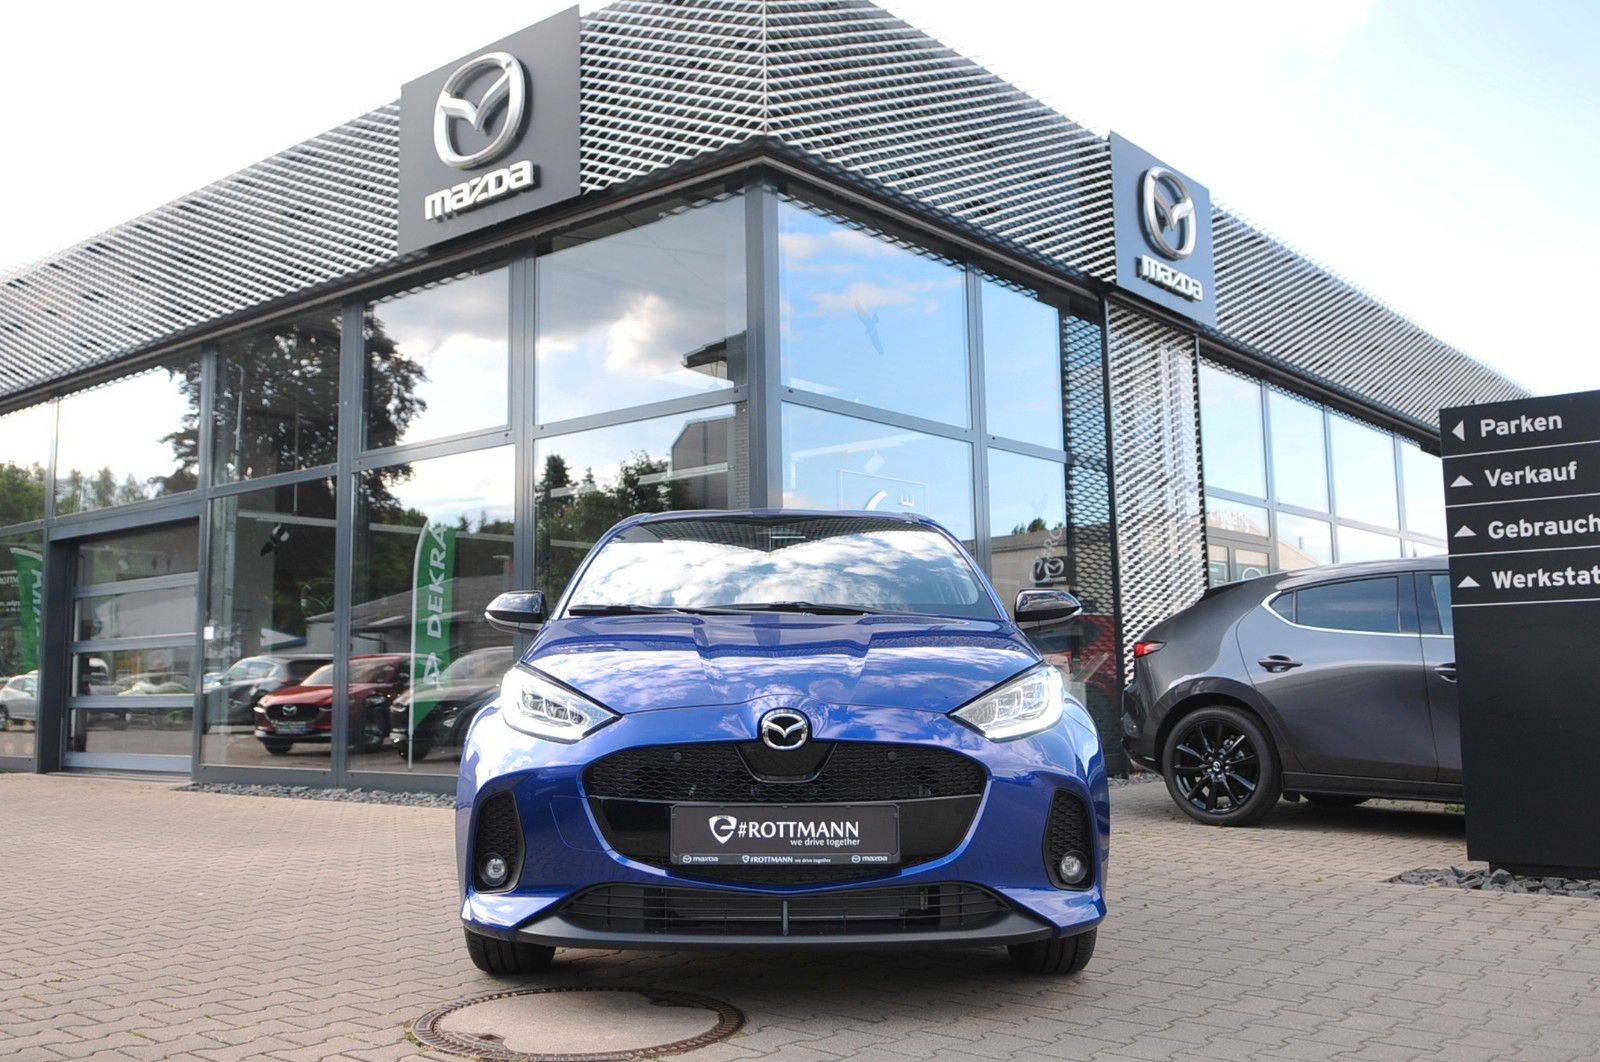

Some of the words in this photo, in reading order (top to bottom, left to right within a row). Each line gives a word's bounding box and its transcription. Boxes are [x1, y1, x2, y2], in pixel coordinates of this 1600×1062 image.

[425, 160, 534, 220] mazda
[1141, 254, 1203, 301] mazda
[1480, 415, 1563, 437] Parken
[1484, 461, 1578, 487] Verkauf
[1488, 514, 1600, 539] Gebrauch
[427, 524, 448, 639] DEKRA
[1492, 565, 1600, 589] Werkstat
[738, 821, 860, 839] #ROTTMANN
[804, 837, 825, 846] drive
[826, 838, 861, 848] together
